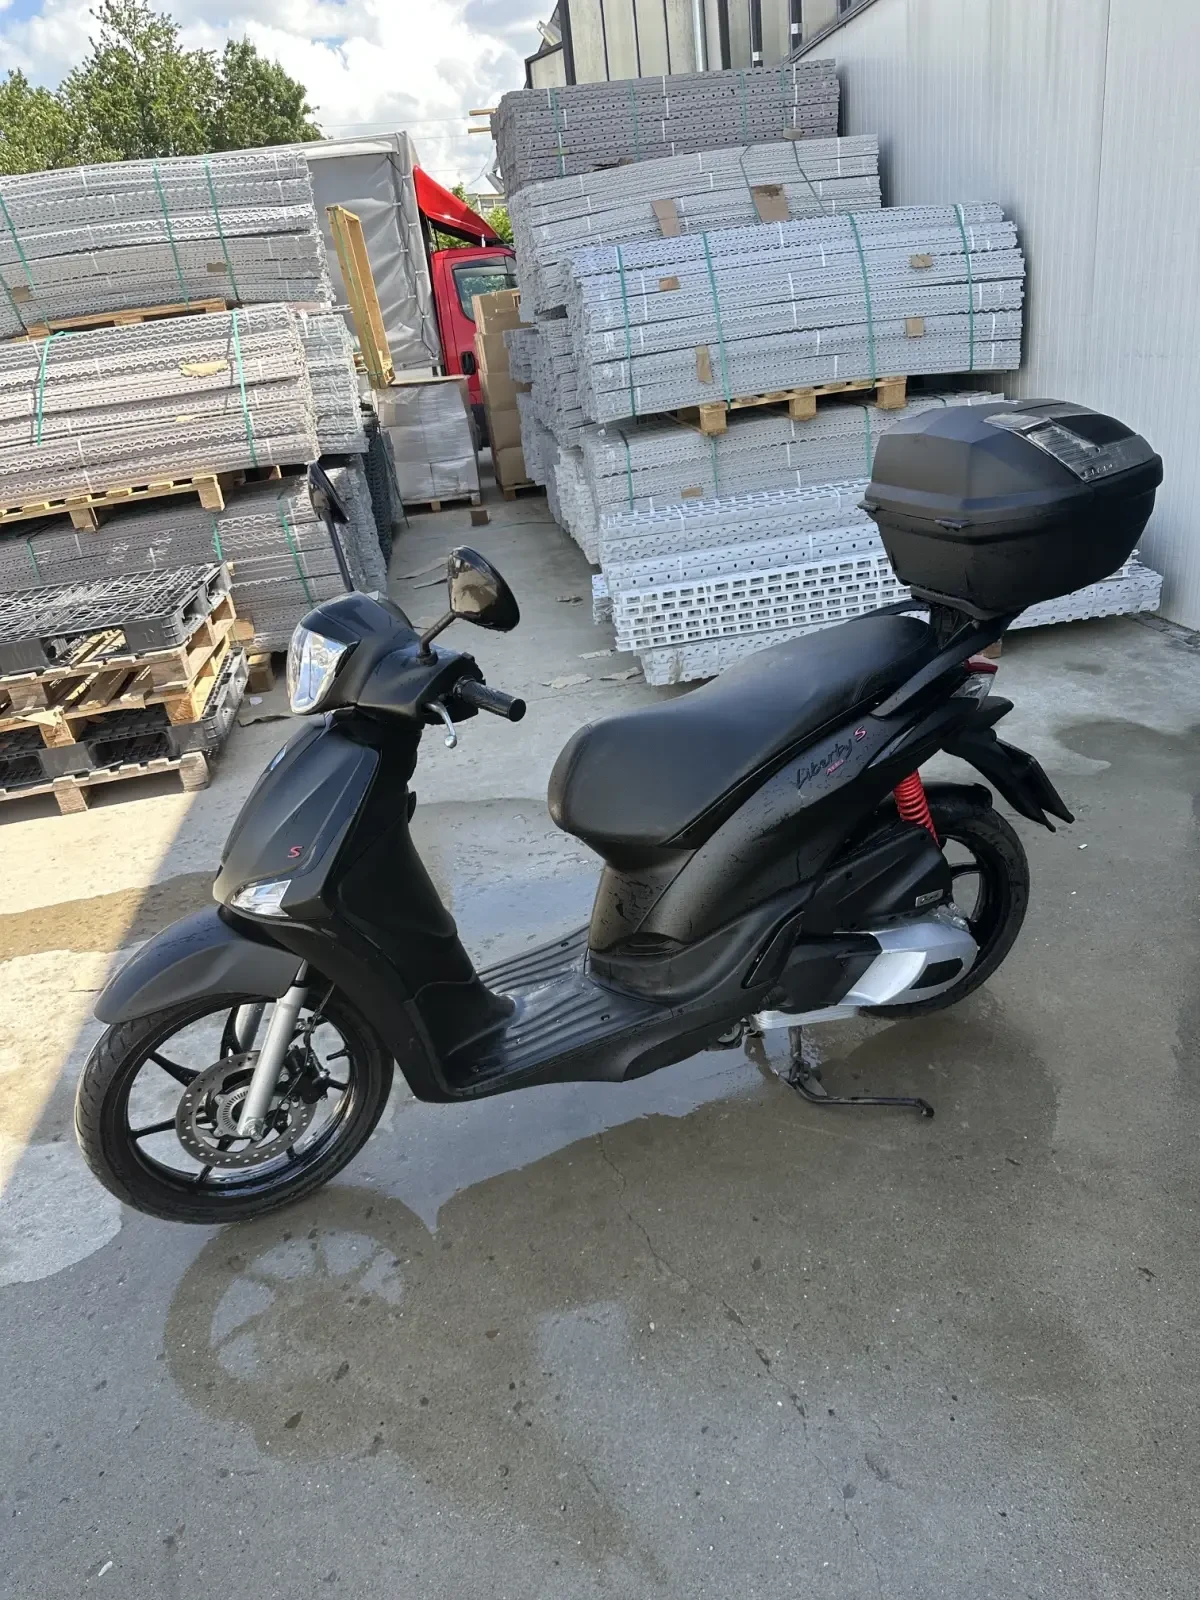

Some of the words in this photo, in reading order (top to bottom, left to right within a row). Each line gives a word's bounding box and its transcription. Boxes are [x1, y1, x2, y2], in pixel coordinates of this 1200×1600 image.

[796, 739, 853, 789] Liberty
[854, 726, 867, 742] S
[287, 844, 304, 859] S
